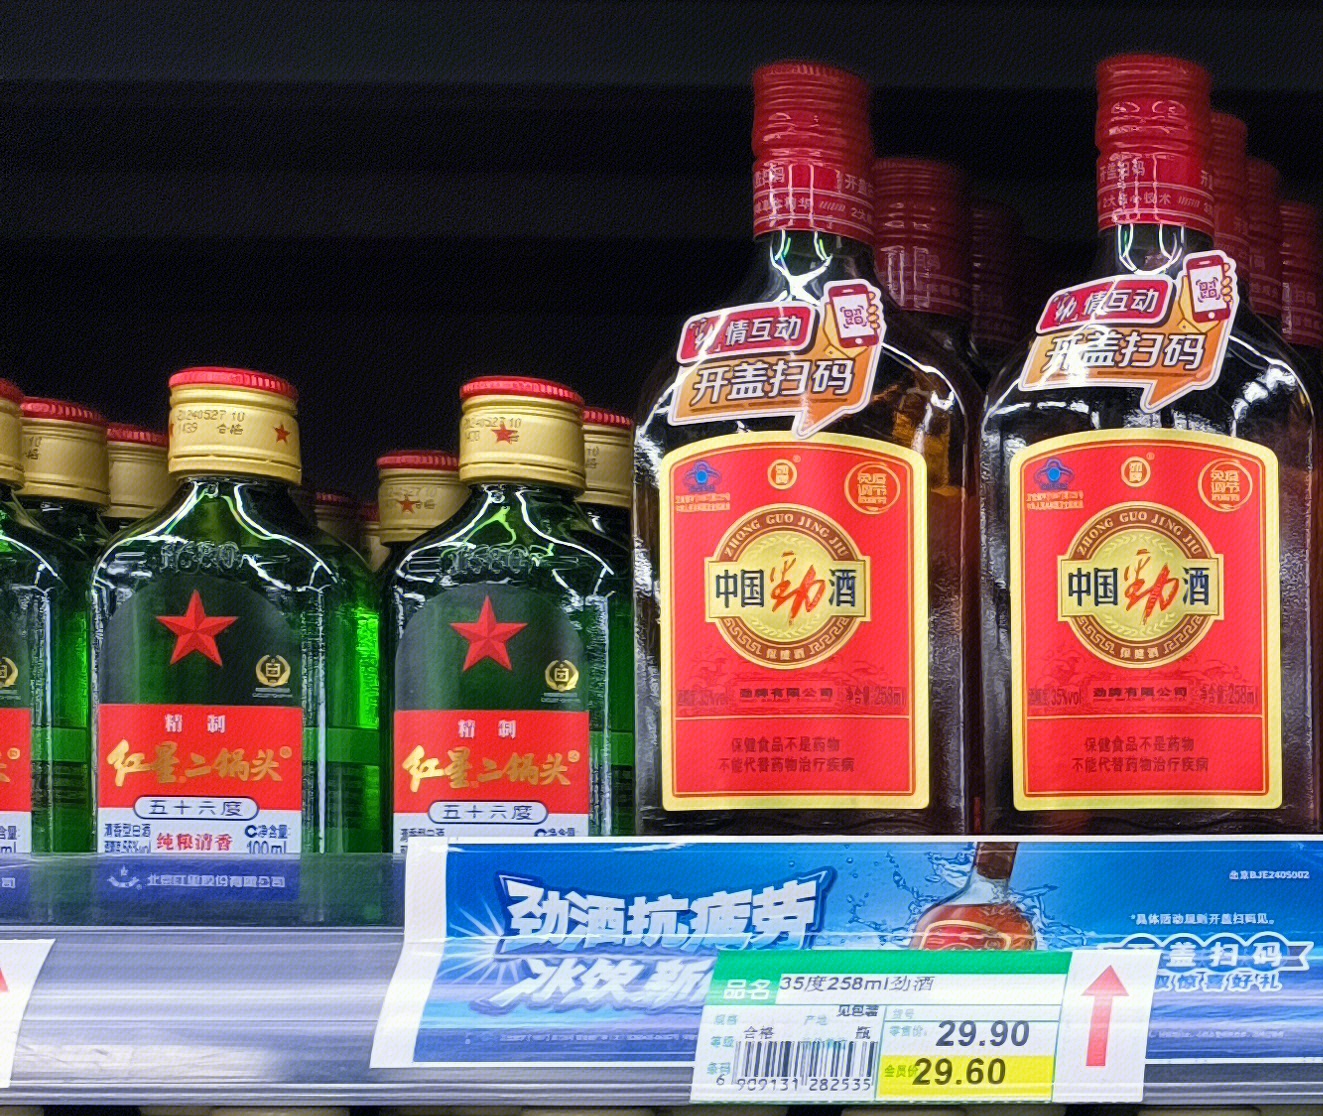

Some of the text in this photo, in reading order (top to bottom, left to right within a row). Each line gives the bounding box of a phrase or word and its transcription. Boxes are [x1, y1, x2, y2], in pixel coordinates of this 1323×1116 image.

[1042, 332, 1206, 370] 开盖扫码
[691, 360, 855, 405] 开盖扫码
[766, 514, 829, 538] GUO JING
[1119, 511, 1147, 523] GUO
[1151, 514, 1184, 536] JING
[732, 736, 840, 752] 保健食品不是药物
[1084, 736, 1195, 752] 保健食品不是药物
[107, 739, 282, 787] 红星二锅头
[402, 745, 571, 793] 红星二锅头
[718, 758, 855, 773] 不能代替药物治疗疾病
[1072, 756, 1209, 773] 不能代替药物治疗疾病
[149, 800, 244, 817] 五十六度
[442, 805, 533, 820] 五十六度
[499, 878, 818, 953] 劲酒抗疲劳
[723, 975, 936, 1000] 品名 35度258ml劲酒
[935, 1019, 1030, 1048] 29.90
[912, 1057, 1006, 1086] 29.60
[808, 1078, 872, 1092] 282535
